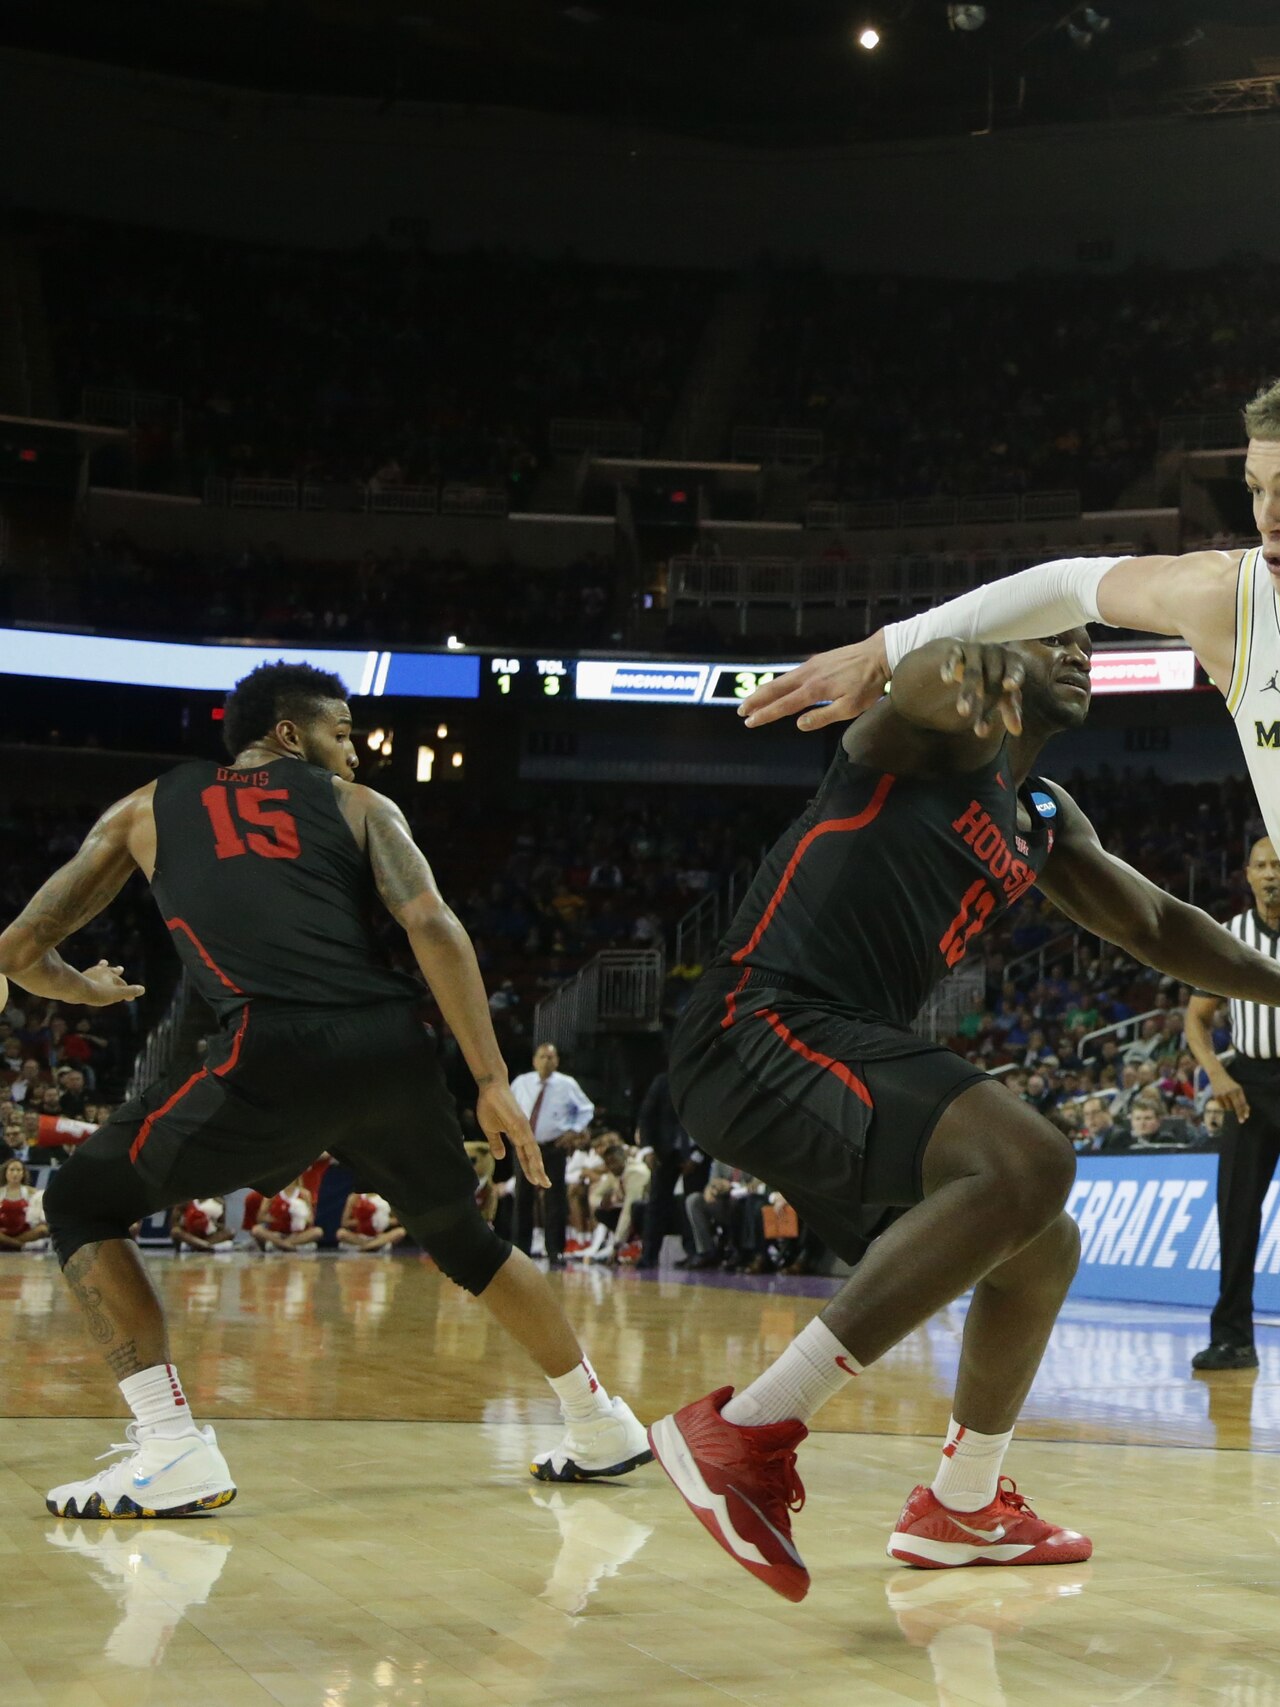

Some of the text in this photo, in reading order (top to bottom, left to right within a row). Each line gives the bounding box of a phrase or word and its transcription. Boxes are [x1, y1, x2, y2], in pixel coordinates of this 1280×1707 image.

[498, 674, 560, 696] 1 3
[215, 767, 270, 787] DAVIS
[200, 784, 302, 860] 15
